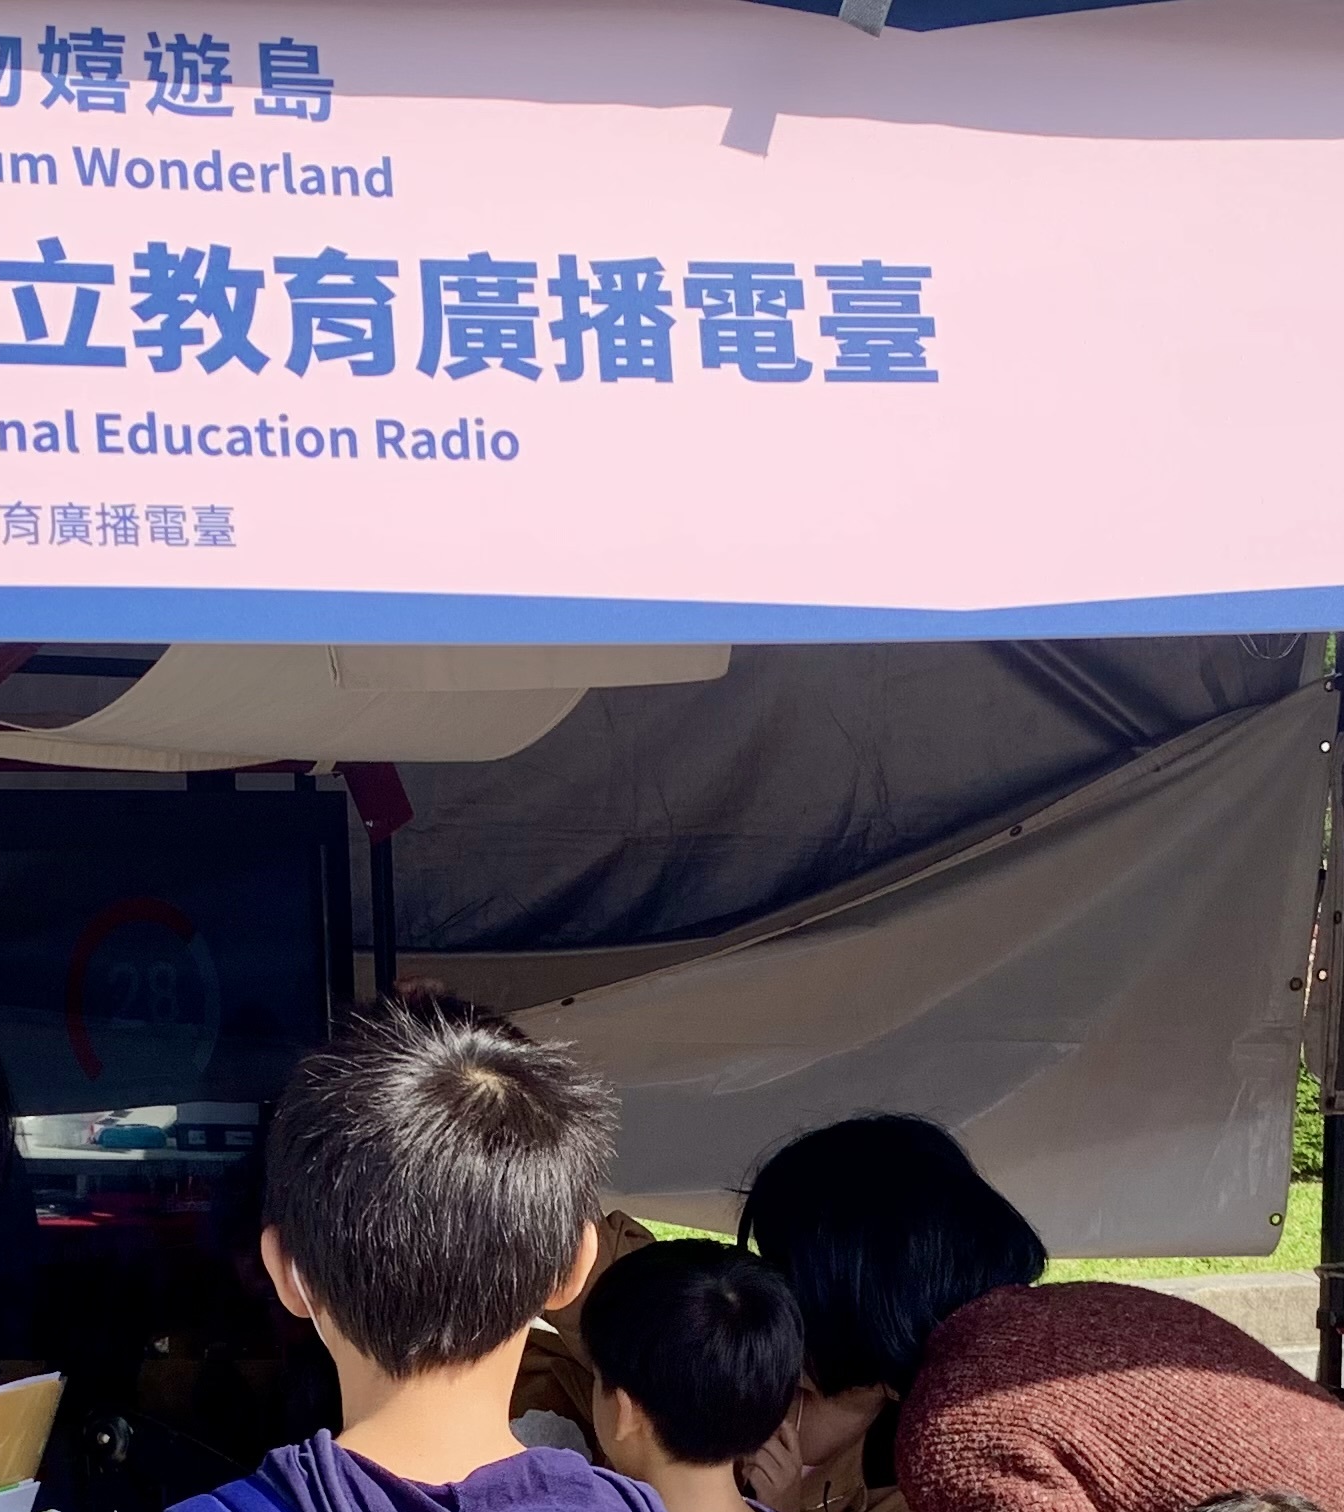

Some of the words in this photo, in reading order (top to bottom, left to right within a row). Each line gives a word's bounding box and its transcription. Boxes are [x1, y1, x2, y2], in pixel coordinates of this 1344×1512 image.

[73, 146, 394, 198] Wonderland
[96, 413, 358, 459] Education
[376, 418, 521, 461] Radio
